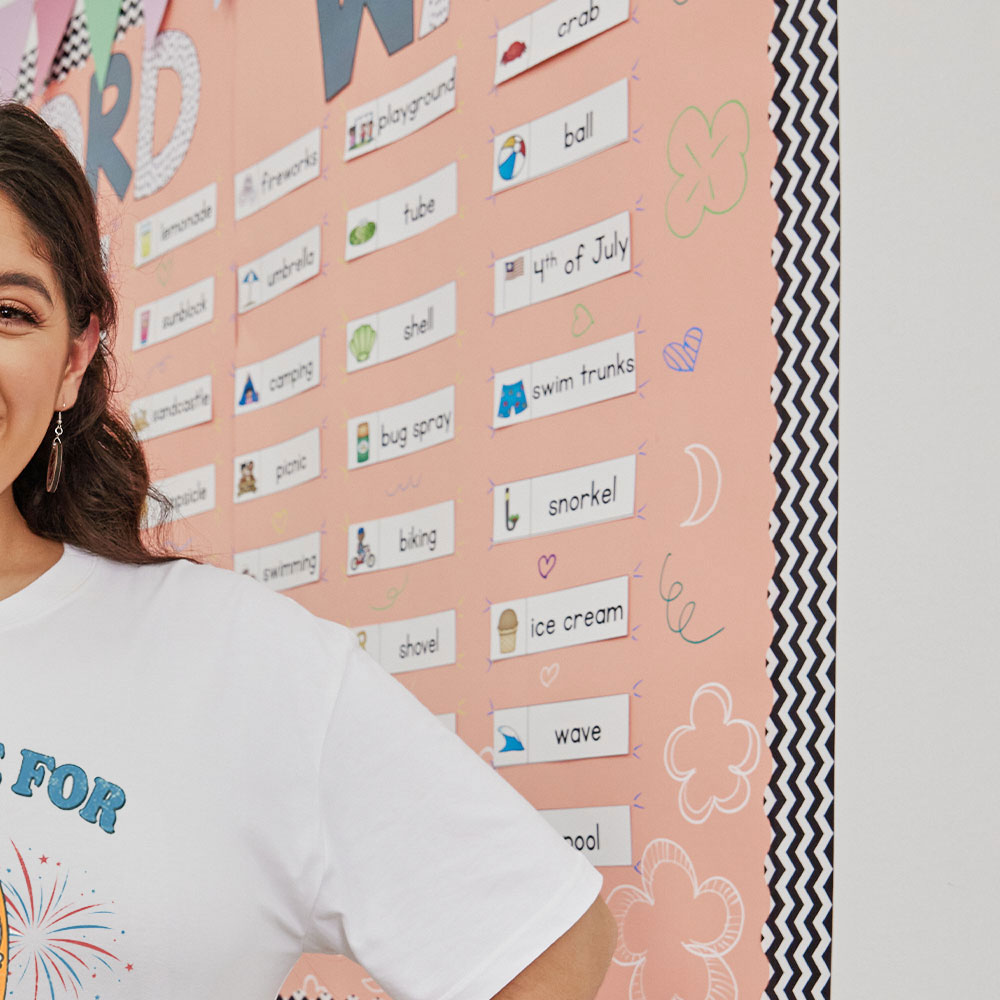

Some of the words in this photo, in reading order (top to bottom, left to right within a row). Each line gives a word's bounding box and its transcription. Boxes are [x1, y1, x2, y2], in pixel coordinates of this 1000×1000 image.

[557, 0, 600, 38] crab
[376, 68, 456, 134] playground
[564, 110, 594, 149] ball
[260, 147, 317, 190] fireworks
[161, 201, 213, 242] lemonade
[403, 196, 436, 225] tube
[267, 247, 315, 287] umbrella
[533, 249, 559, 283] 4th
[564, 243, 585, 275] of
[592, 230, 629, 265] July
[162, 292, 208, 331] sunblock
[403, 306, 435, 341] shell
[269, 360, 315, 392] camping
[532, 374, 574, 400] swim
[581, 352, 635, 387] trunks
[152, 386, 211, 422] sandcastle
[380, 423, 407, 449] bug
[412, 410, 453, 440] spray
[275, 454, 307, 484] picnic
[548, 475, 618, 517] snorkel
[399, 526, 437, 552] biking
[263, 553, 317, 582] swimming
[530, 616, 556, 639] ice
[563, 603, 625, 633] cream
[398, 627, 440, 660] shovel
[554, 724, 602, 745] wave
[11, 748, 127, 834] FOR
